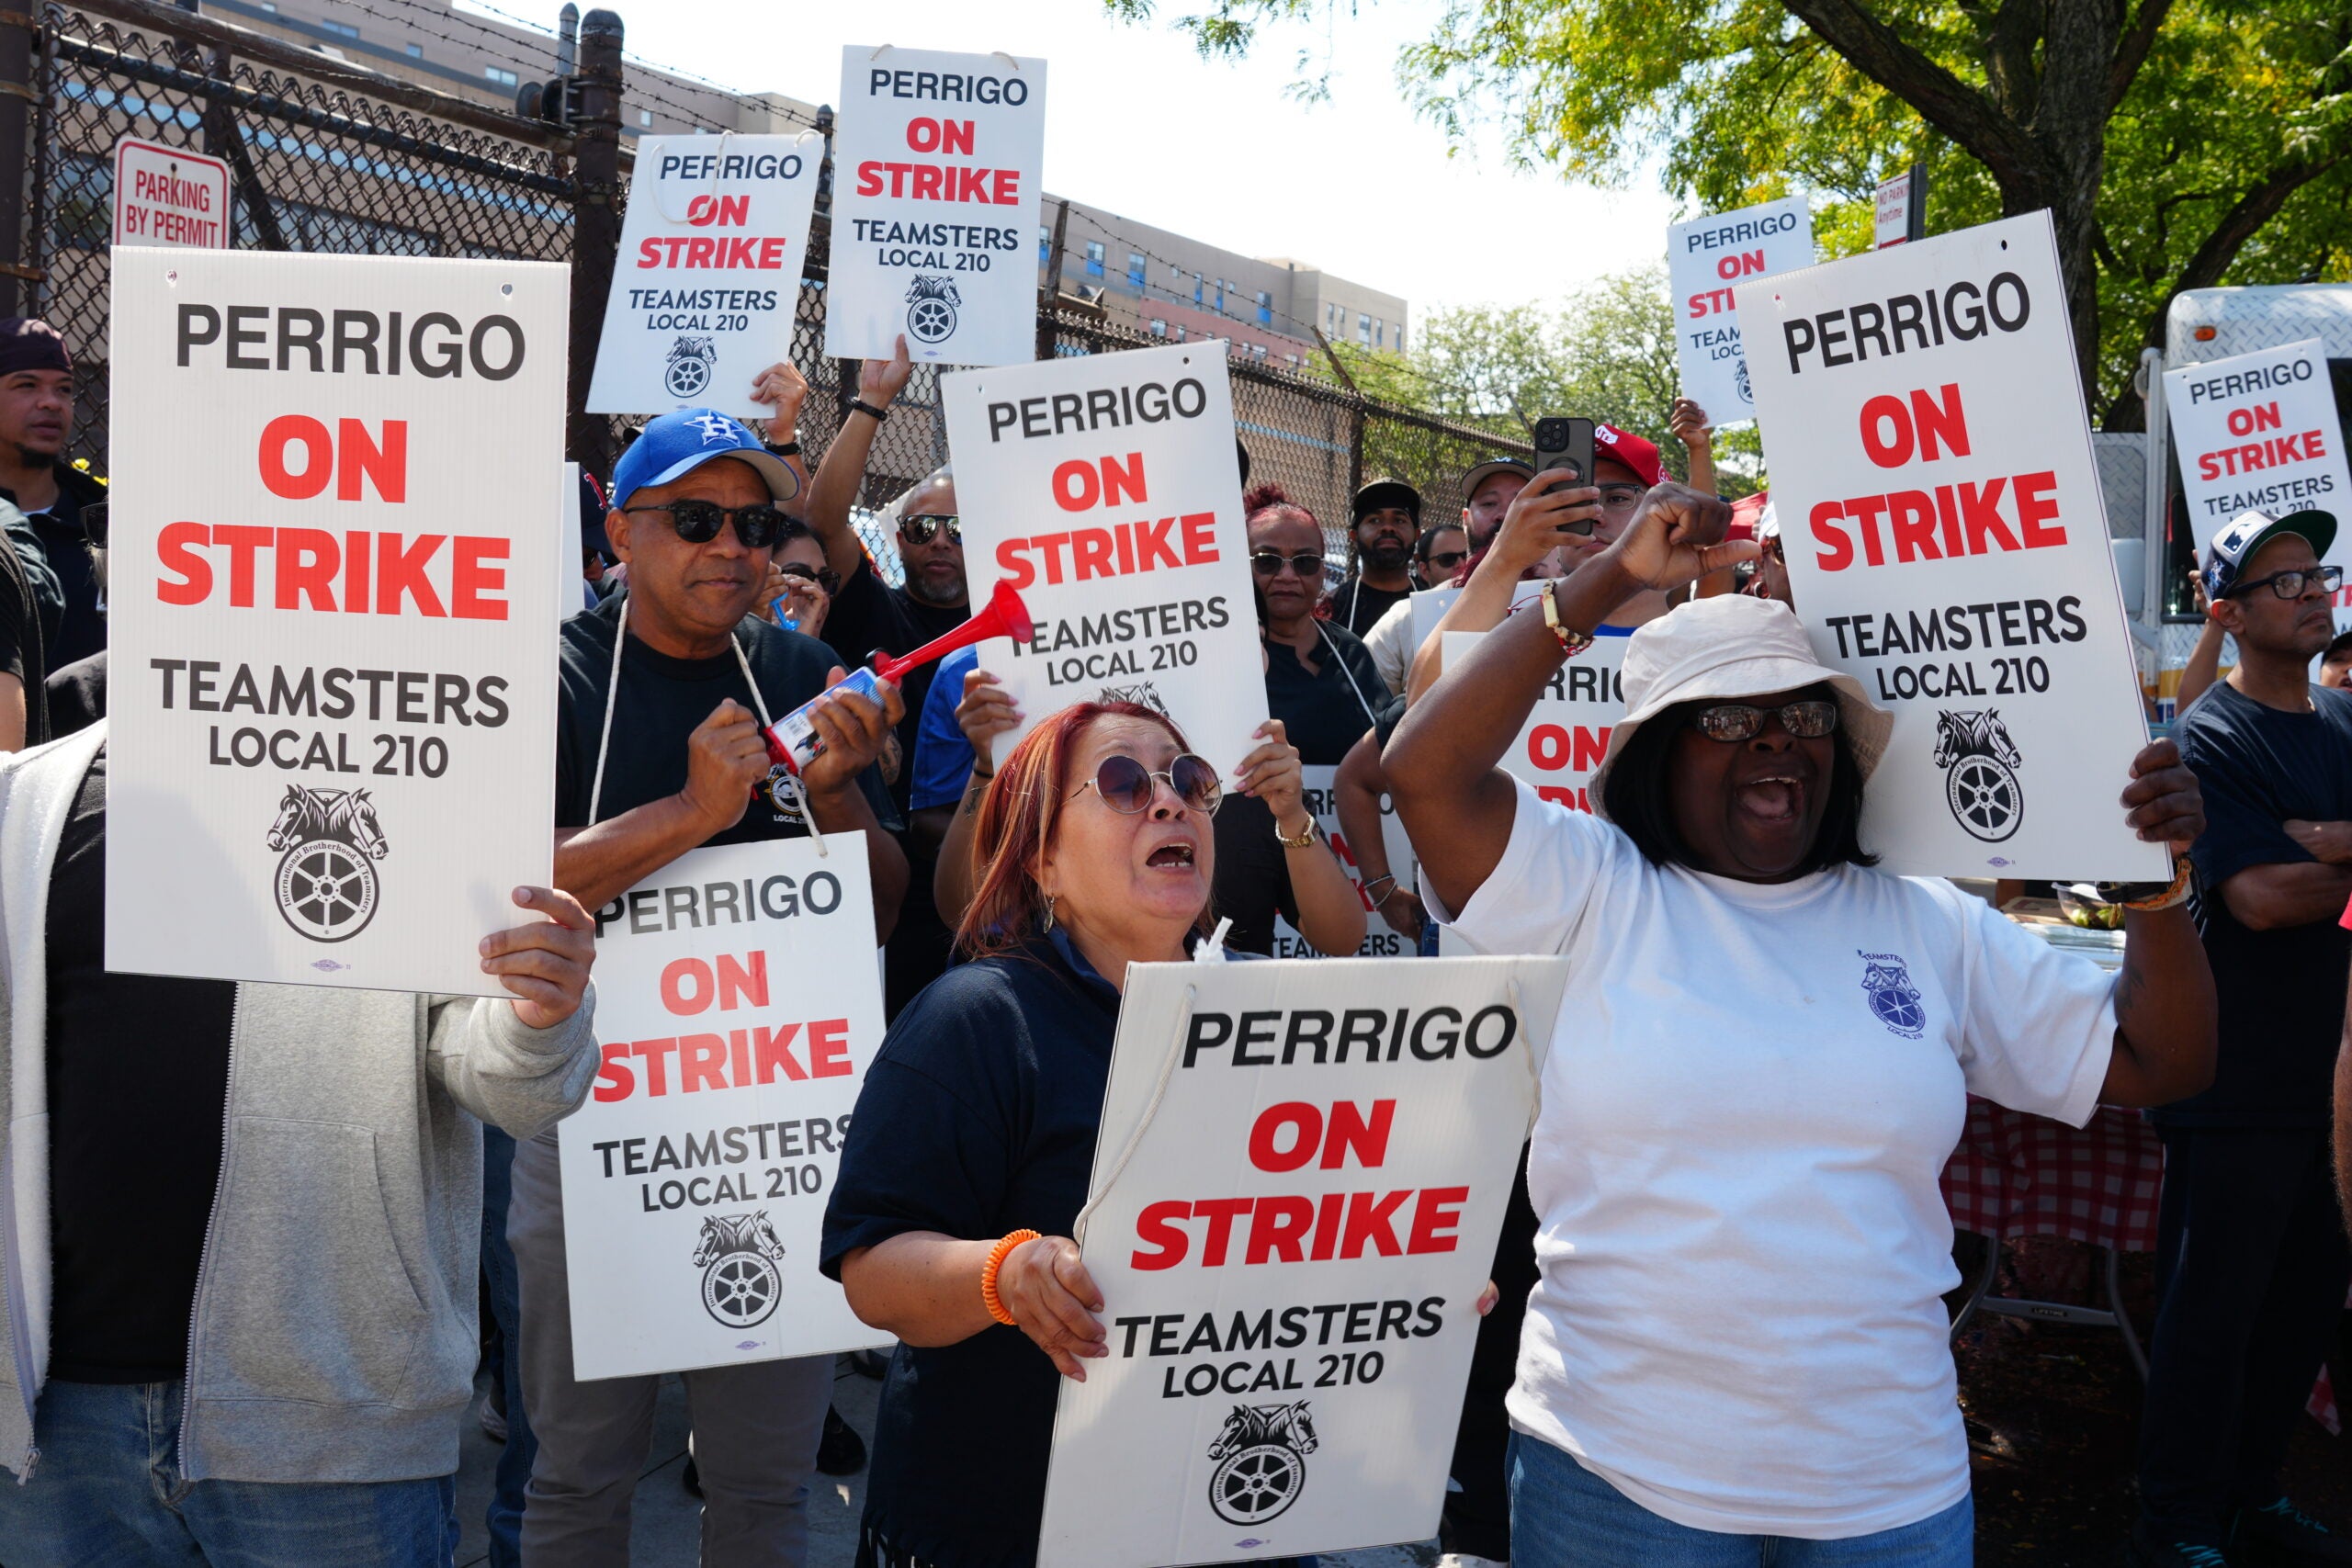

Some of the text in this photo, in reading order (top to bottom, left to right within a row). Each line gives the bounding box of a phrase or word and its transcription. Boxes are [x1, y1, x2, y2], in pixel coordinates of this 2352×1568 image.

[870, 70, 1028, 106] PERRIGO
[906, 117, 975, 154] ON
[660, 154, 802, 180] PERRIGO
[856, 162, 1020, 205] STRIKE
[135, 170, 209, 212] PARKING
[687, 195, 750, 227] ON
[126, 205, 218, 246] BY PERMIT
[853, 220, 1018, 250] TEAMSTERS
[1688, 212, 1796, 253] PERRIGO
[637, 237, 786, 269] STRIKE
[878, 248, 990, 272] LOCAL 210
[1717, 249, 1765, 280] ON
[628, 289, 777, 310] TEAMSTERS
[647, 314, 748, 332] LOCAL 210
[1783, 272, 2030, 374] PERRIGO
[176, 303, 526, 381] PERRIGO
[1712, 344, 1745, 361] LOC
[2189, 359, 2312, 405] PERRIGO
[988, 378, 1206, 442] PERRIGO
[1859, 382, 1971, 468] ON
[2227, 401, 2282, 436] ON
[258, 414, 408, 503] ON
[2198, 430, 2326, 481] STRIKE
[1052, 452, 1148, 512] ON
[2204, 475, 2335, 516] TEAMSTERS
[1809, 469, 2068, 572] STRIKE
[156, 521, 511, 621] STRIKE
[995, 512, 1220, 592] STRIKE
[1826, 595, 2087, 659] TEAMSTERS
[1046, 640, 1198, 685] LOCAL 210
[1876, 656, 2050, 701] LOCAL 210
[151, 659, 509, 728] TEAMSTERS
[209, 726, 448, 778] LOCAL 210
[1528, 724, 1612, 772] ON
[1961, 757, 1999, 771] Brotherhood
[2007, 778, 2018, 817] Teamsters
[774, 815, 797, 823] LOCAL
[281, 842, 371, 914] International Brotherhood of Teamsters
[594, 871, 842, 939] PERRIGO
[660, 950, 770, 1016] ON
[1861, 953, 1906, 968] TEAMSTERS
[1182, 1004, 1517, 1068] PERRIGO
[1887, 1026, 1912, 1039] LOCAL
[593, 1018, 854, 1102] STRIKE
[1249, 1100, 1397, 1173] ON
[642, 1164, 822, 1213] LOCAL 210
[1130, 1186, 1470, 1270] STRIKE
[1114, 1296, 1446, 1358] TEAMSTERS
[1162, 1351, 1384, 1398] LOCAL 210
